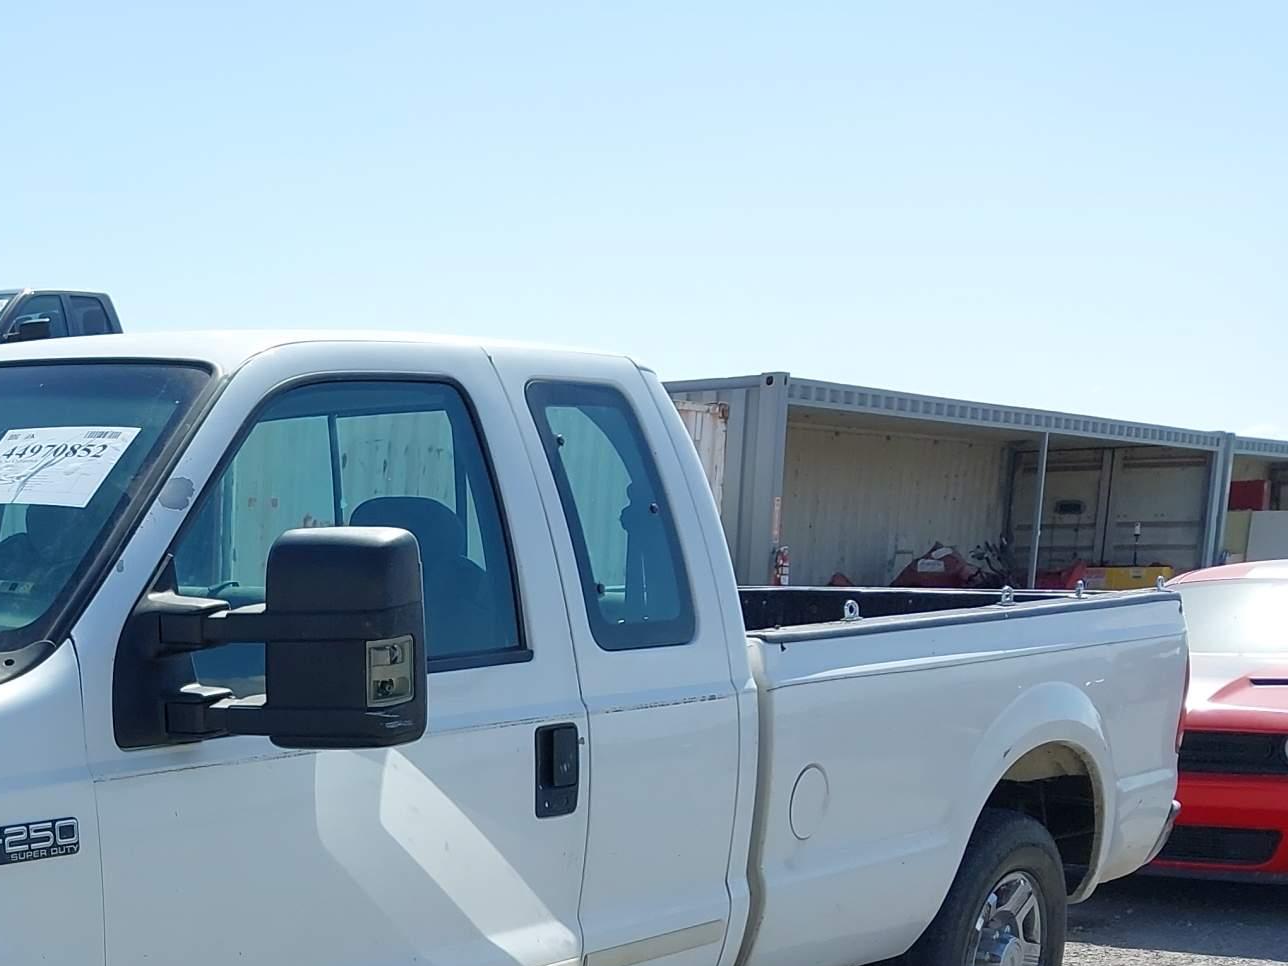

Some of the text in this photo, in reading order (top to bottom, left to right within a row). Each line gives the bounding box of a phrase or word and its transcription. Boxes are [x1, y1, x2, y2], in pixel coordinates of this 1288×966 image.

[2, 443, 108, 459] 44970852
[11, 845, 79, 861] SUPER DUTY
